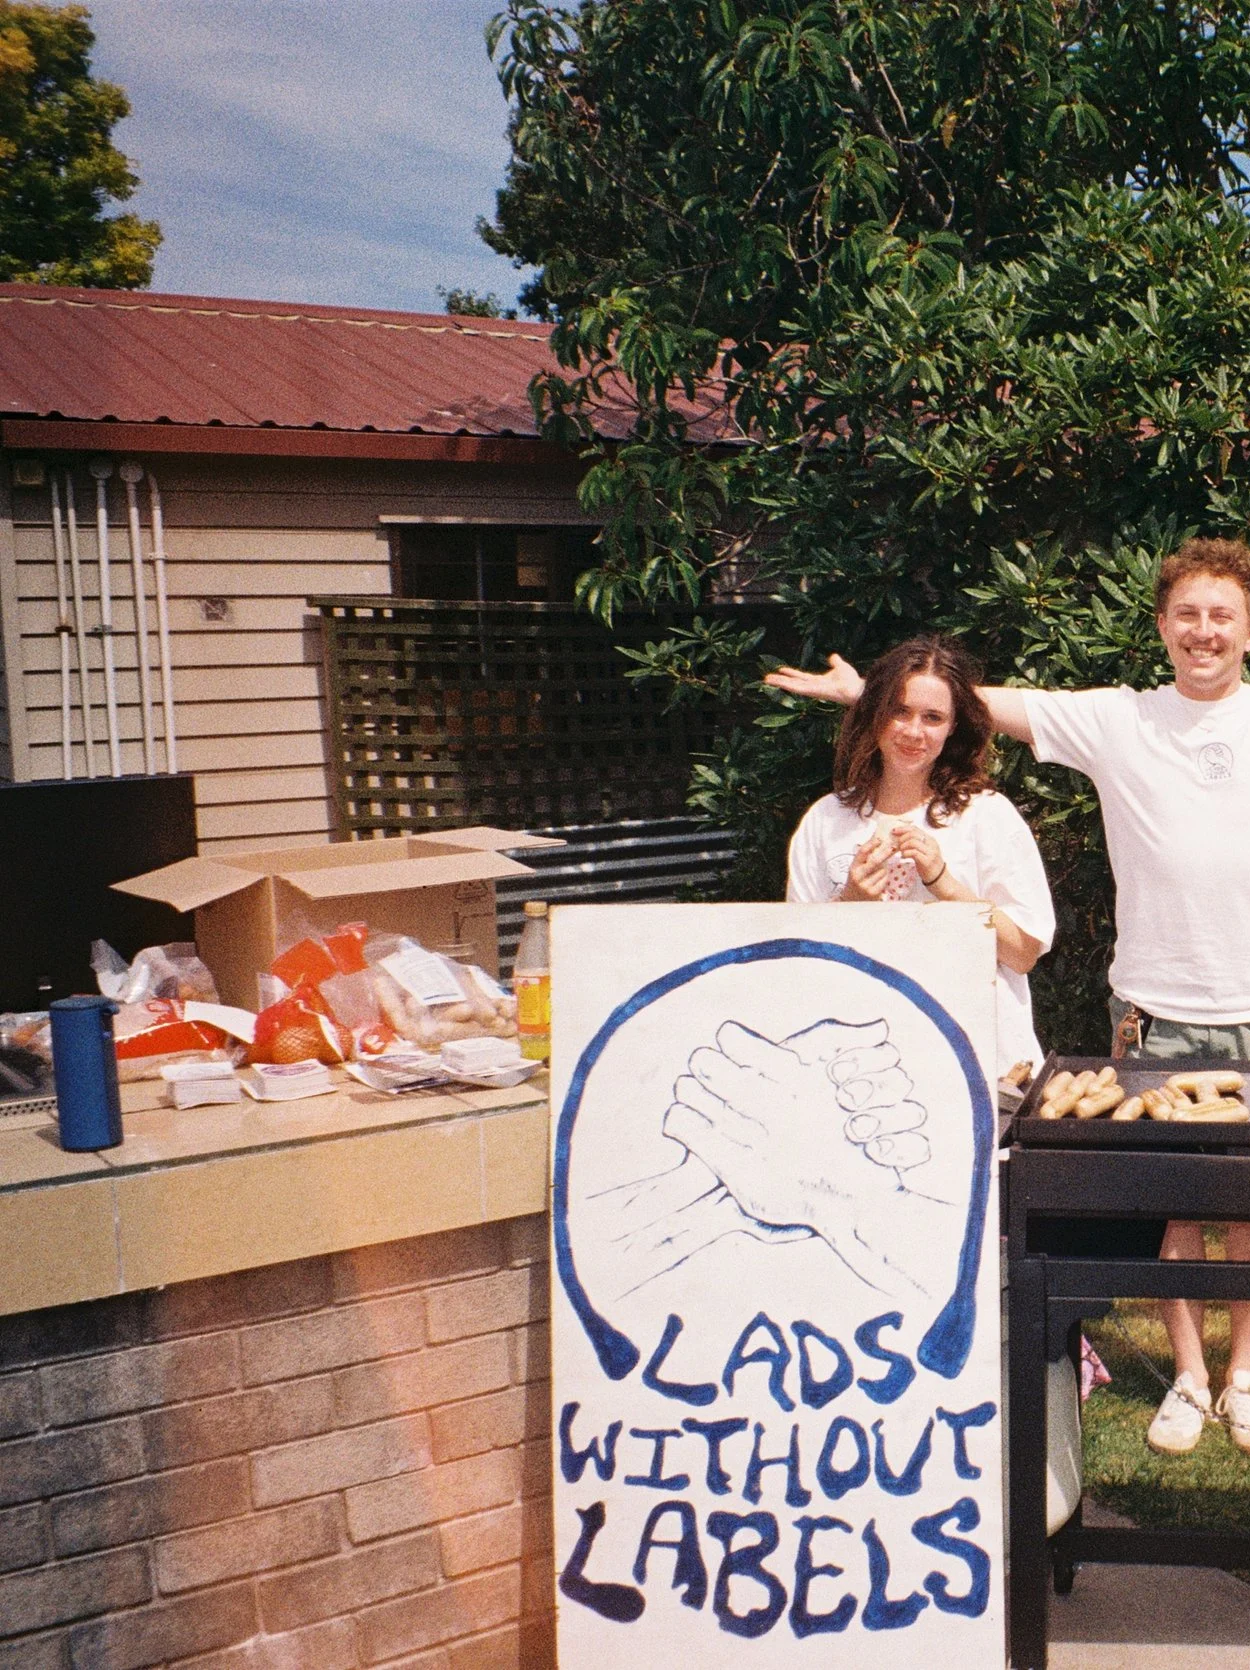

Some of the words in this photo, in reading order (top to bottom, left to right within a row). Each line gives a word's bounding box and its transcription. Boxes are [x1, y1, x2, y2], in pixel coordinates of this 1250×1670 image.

[642, 1311, 917, 1412] LADS
[560, 1401, 997, 1507] WITHOUT
[559, 1496, 992, 1639] LABELS
